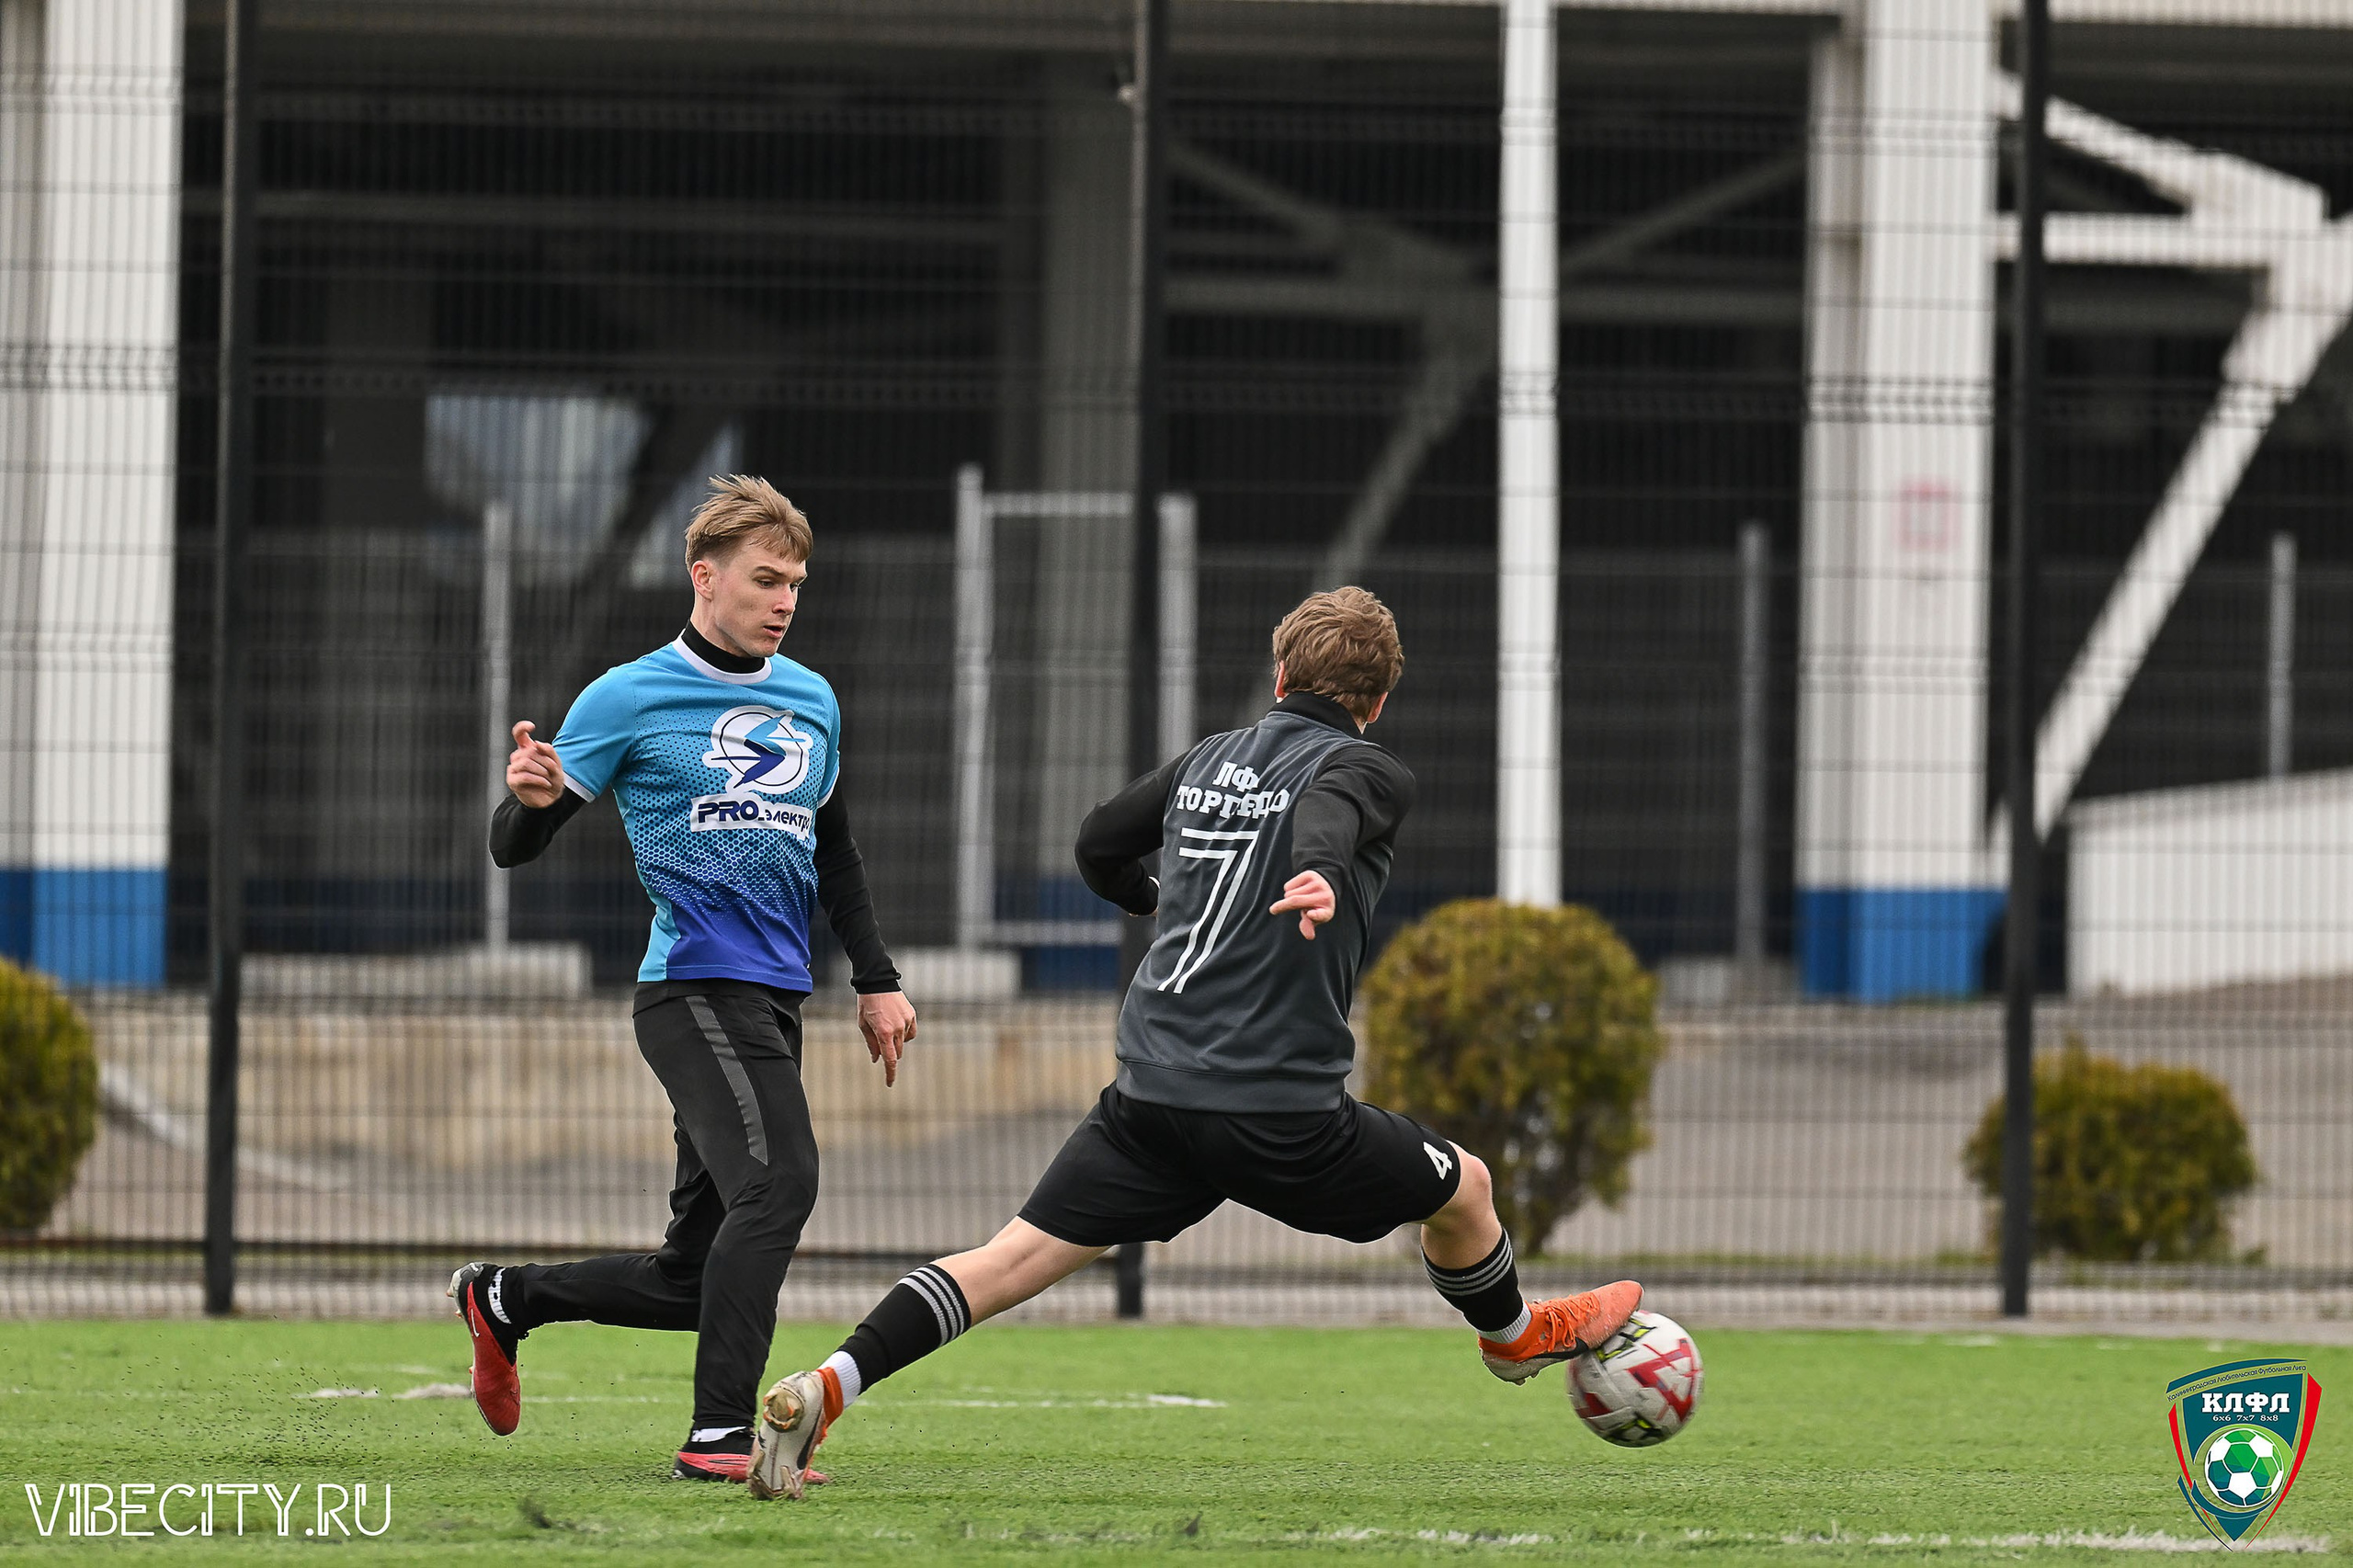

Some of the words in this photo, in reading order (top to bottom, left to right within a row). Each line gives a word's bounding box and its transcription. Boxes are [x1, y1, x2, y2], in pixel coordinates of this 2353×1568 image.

[1211, 761, 1260, 793] ЛФ
[1156, 827, 1260, 994] 7
[1423, 1142, 1452, 1180] 4
